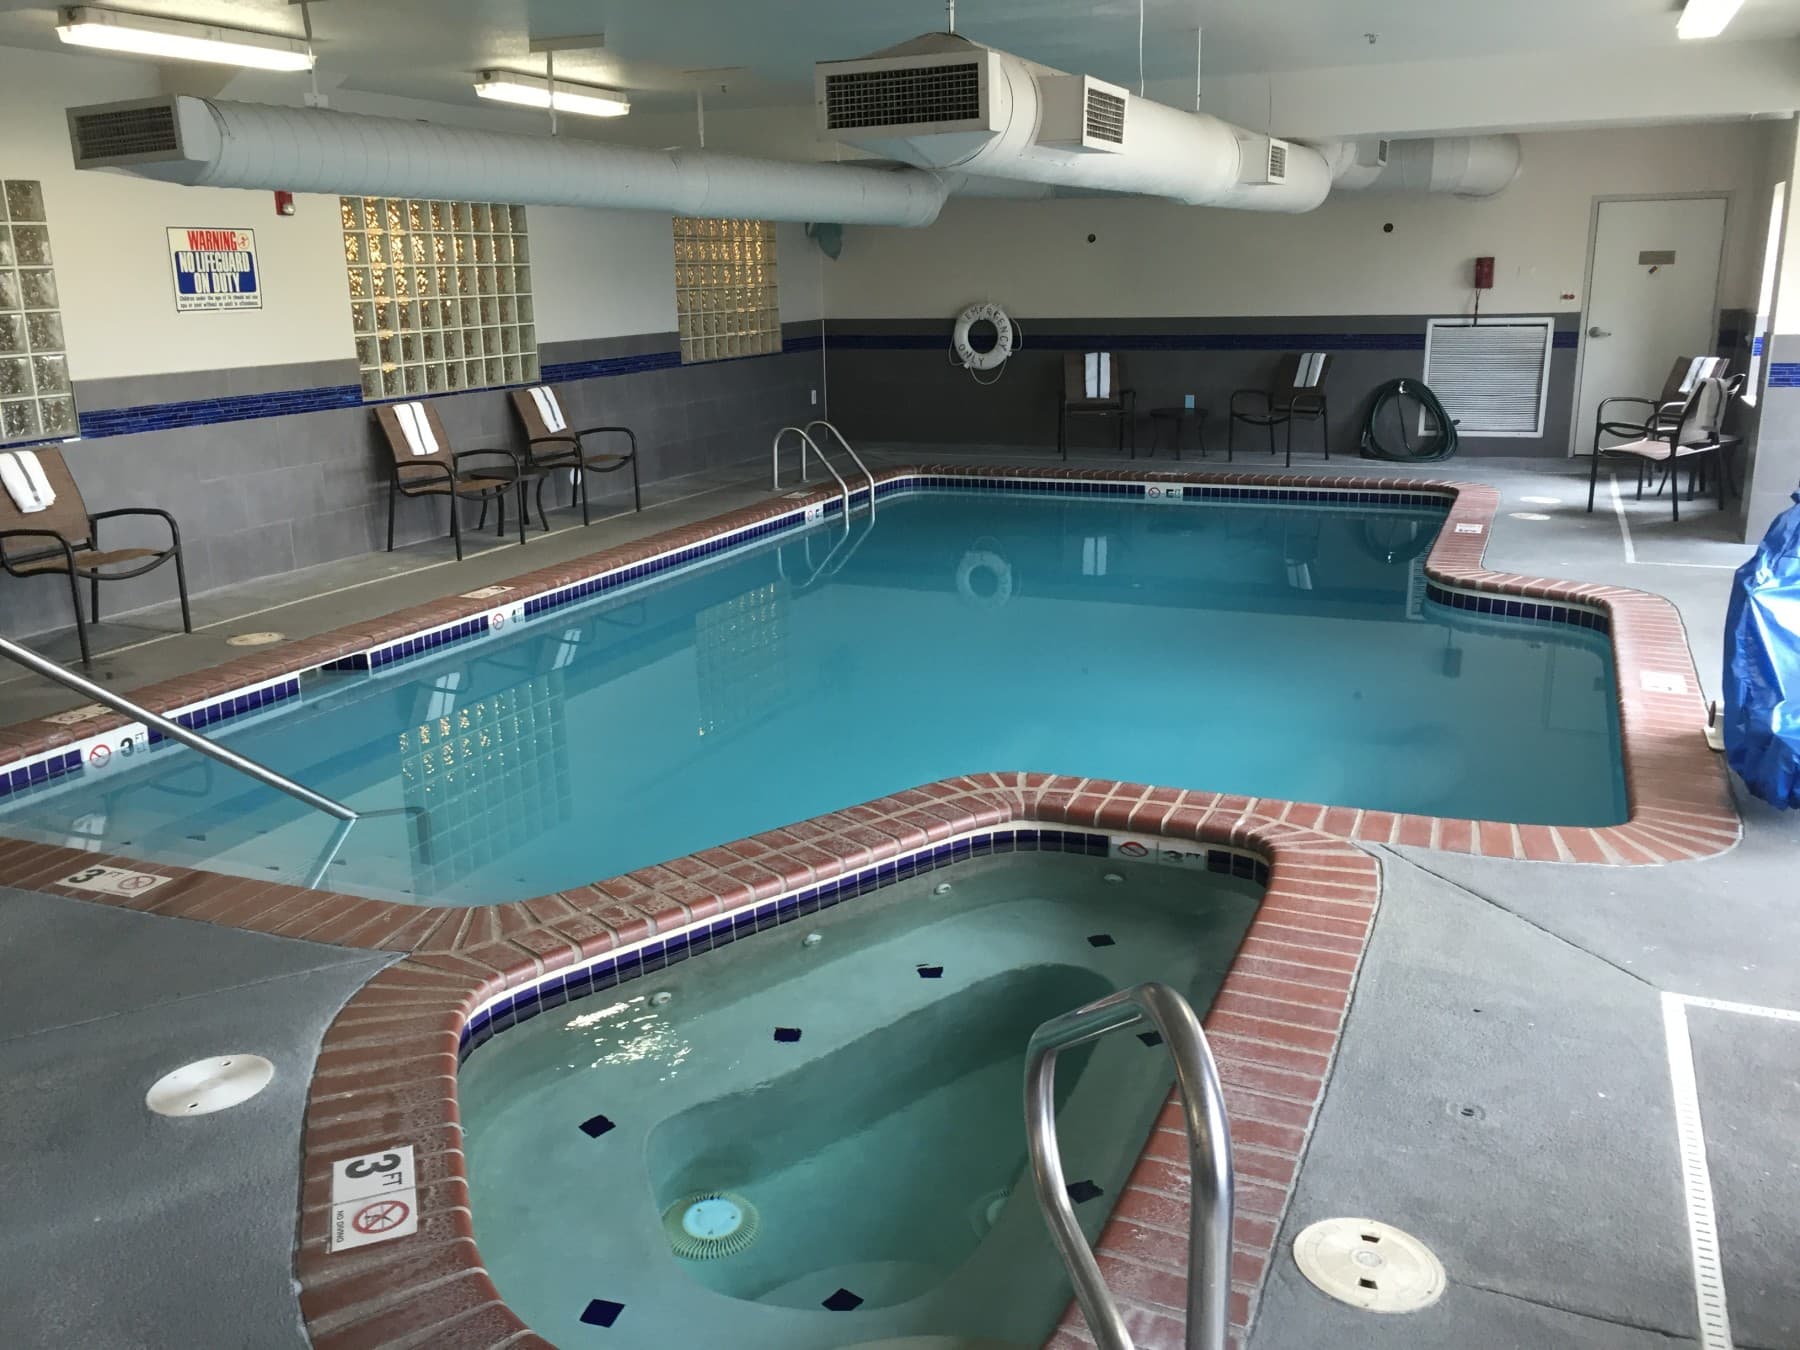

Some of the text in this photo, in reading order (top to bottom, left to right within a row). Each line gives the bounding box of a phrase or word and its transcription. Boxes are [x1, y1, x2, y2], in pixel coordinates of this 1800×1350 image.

[187, 231, 237, 251] WARNING
[179, 252, 250, 273] NO LIFEGUARD
[194, 273, 240, 293] ON DUTY
[68, 868, 106, 883] 3
[345, 1153, 403, 1186] 3 FT
[336, 1210, 344, 1222] NO
